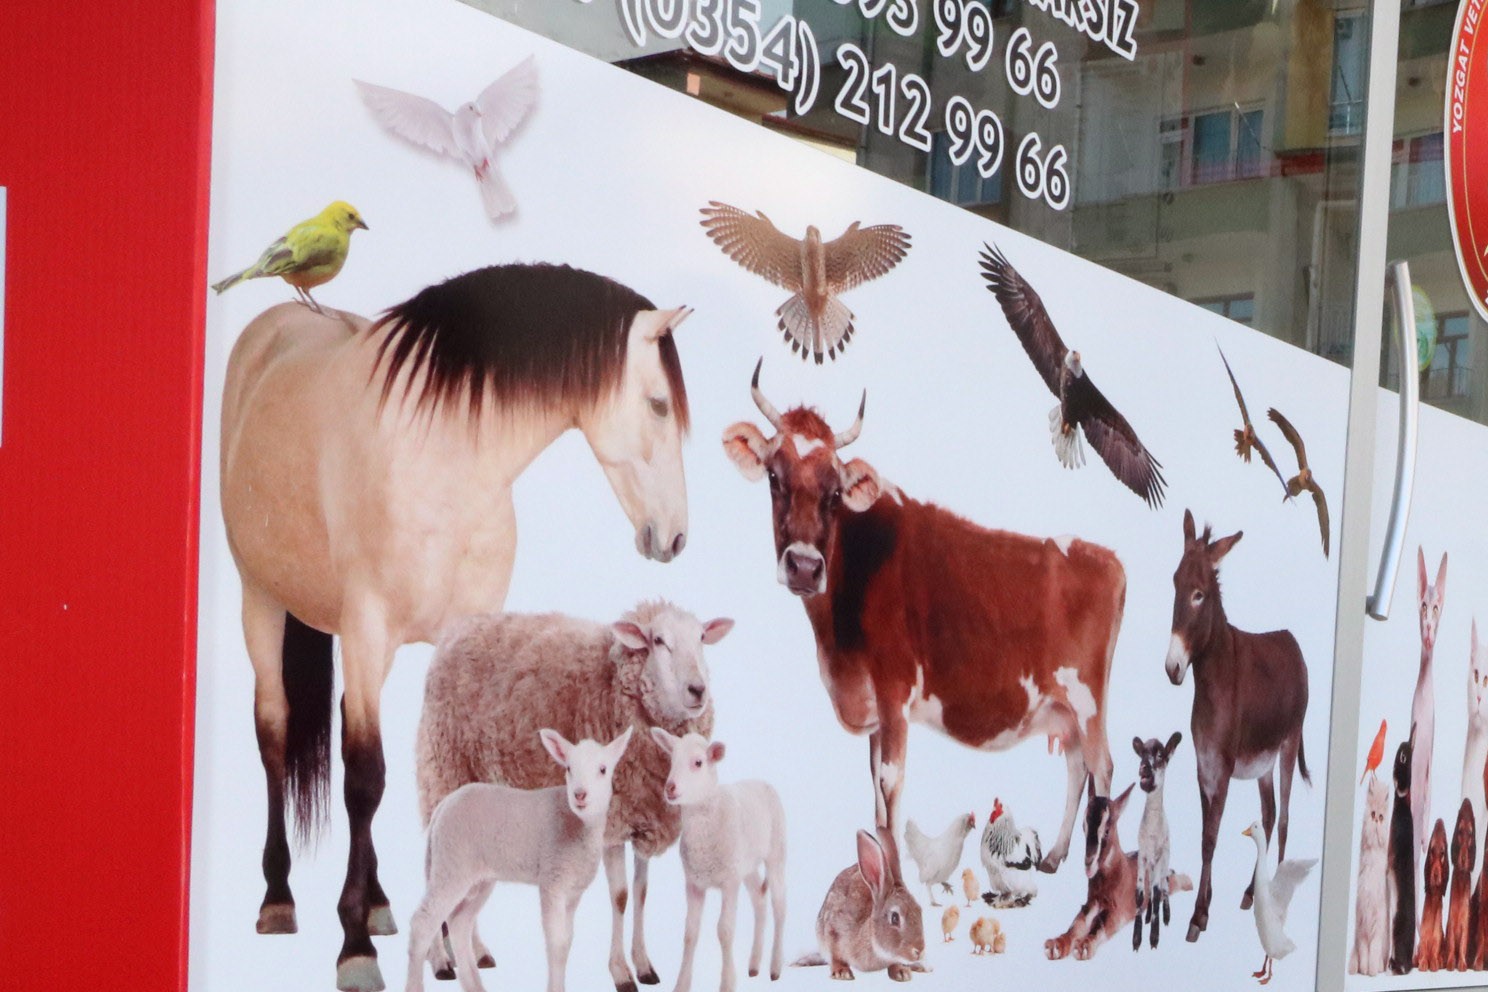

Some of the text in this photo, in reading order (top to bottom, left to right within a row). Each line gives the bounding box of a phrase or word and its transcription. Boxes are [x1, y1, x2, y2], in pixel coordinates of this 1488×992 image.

[933, 0, 994, 72] 99
[1005, 27, 1061, 109] 66
[1451, 38, 1470, 134] YOZGAT
[834, 43, 932, 152] 212
[945, 95, 1004, 179] 99
[1015, 131, 1070, 211] 66
